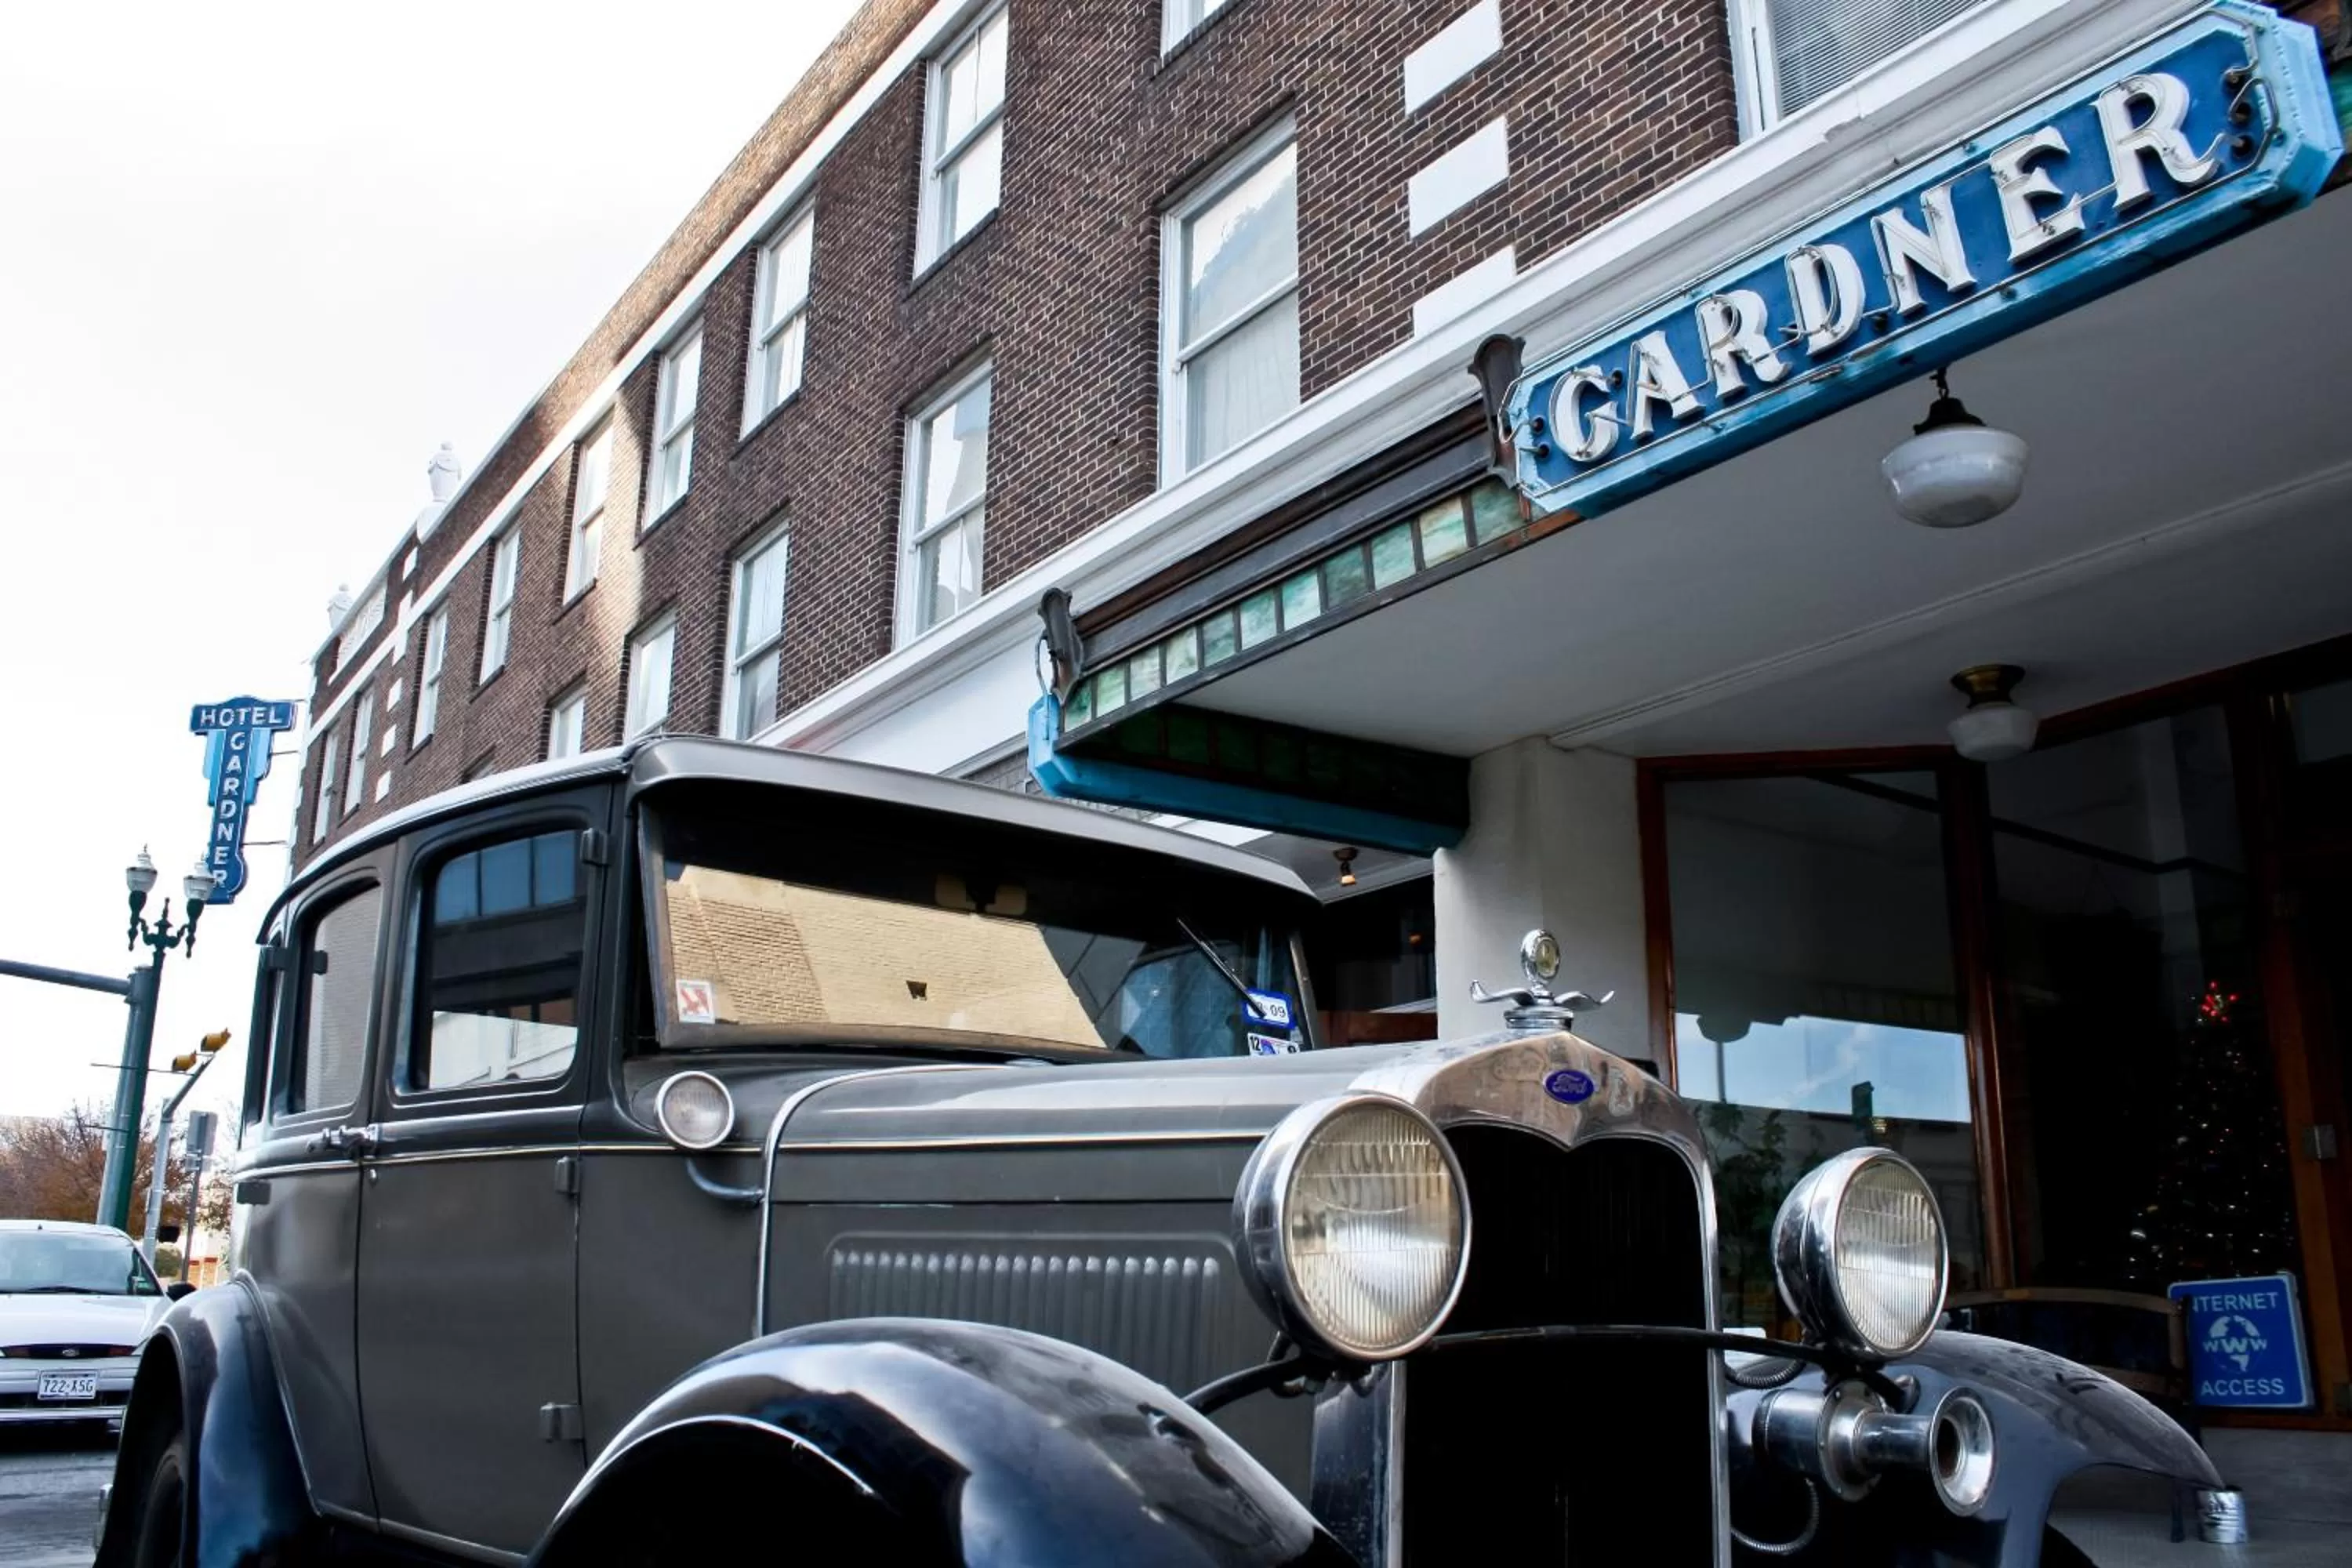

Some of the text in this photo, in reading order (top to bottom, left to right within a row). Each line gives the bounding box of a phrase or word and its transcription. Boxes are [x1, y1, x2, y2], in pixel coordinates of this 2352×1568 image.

[1549, 72, 2219, 464] GARDNER
[200, 707, 283, 726] HOTEL
[212, 731, 246, 888] GARDNER
[1552, 1073, 1588, 1094] Ford
[2192, 1291, 2280, 1313] TERNET
[2200, 1377, 2285, 1396] ACCESS
